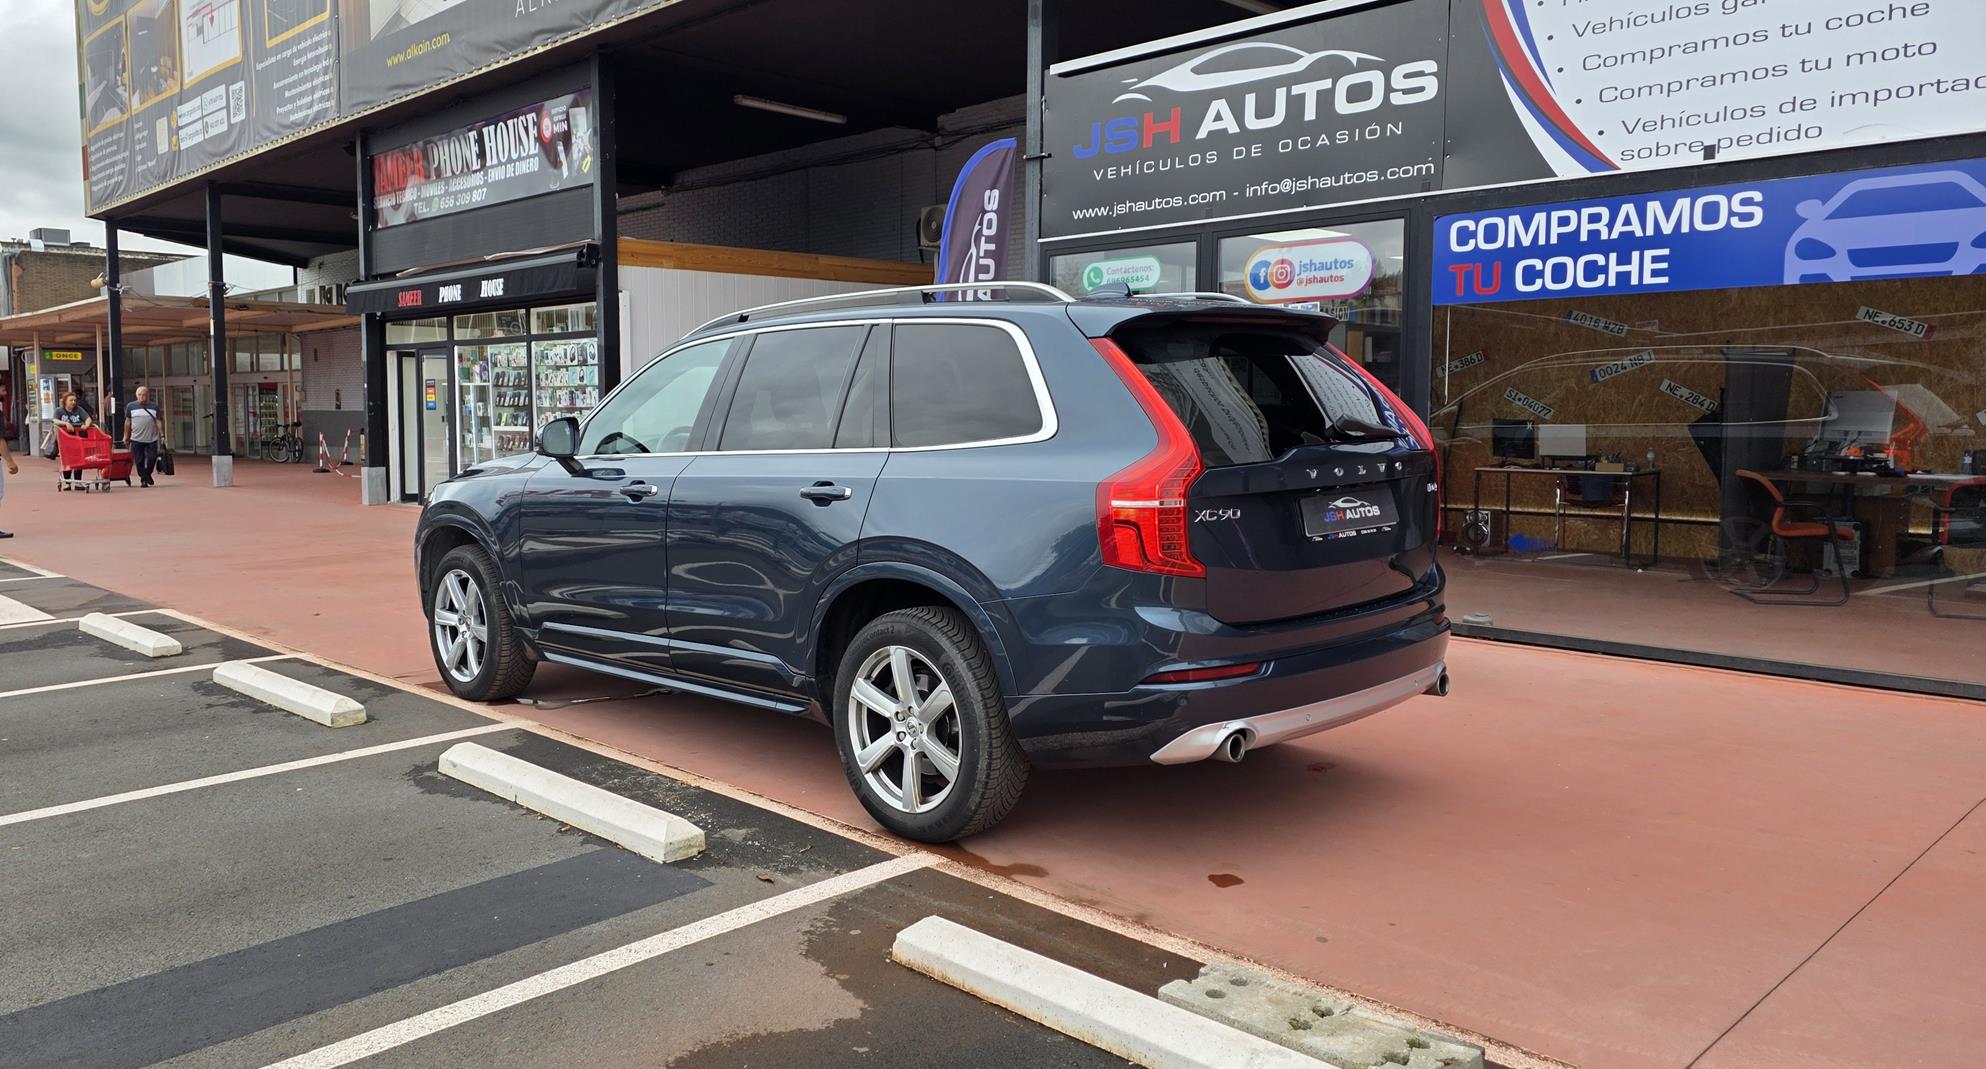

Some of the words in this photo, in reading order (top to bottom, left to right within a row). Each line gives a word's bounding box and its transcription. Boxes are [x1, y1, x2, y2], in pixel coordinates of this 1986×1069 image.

[1572, 2, 1710, 38] Vehículos
[1582, 29, 1769, 72] Compramos
[1780, 21, 1812, 38] tu
[1825, 2, 1930, 31] coche
[387, 32, 450, 68] www.alkain.com
[1599, 64, 1788, 104] Compramos
[1799, 57, 1832, 73] tu
[1845, 41, 1937, 67] moto
[1073, 106, 1181, 160] JSH
[1195, 59, 1439, 140] AUTOS
[1621, 105, 1766, 136] Vehículos
[1778, 96, 1817, 114] de
[428, 130, 481, 180] PHONE
[482, 112, 539, 167] HOUSE
[1093, 150, 1218, 181] VEHÍCULOS
[1233, 143, 1262, 160] DE
[1278, 121, 1403, 153] OCASIÓN
[1620, 139, 1705, 161] sobre
[1716, 123, 1823, 153] pedido
[1072, 188, 1226, 220] www.jshautos.com
[1245, 160, 1435, 198] info@jshautos.com
[1449, 190, 1764, 253] COMPRAMOS
[976, 188, 1000, 300] AUTOS
[1297, 258, 1354, 276] jshautos
[1297, 274, 1344, 286] @jshautos
[1448, 261, 1501, 296] TU
[1515, 248, 1670, 292] COCHE
[438, 284, 462, 303] PHONE
[480, 278, 504, 298] HOUSE
[1306, 461, 1403, 480] VOLVO
[1194, 508, 1240, 522] XC90
[1324, 511, 1345, 522] JSH
[1346, 505, 1380, 520] AUTOS
[1339, 530, 1357, 538] AUTOS
